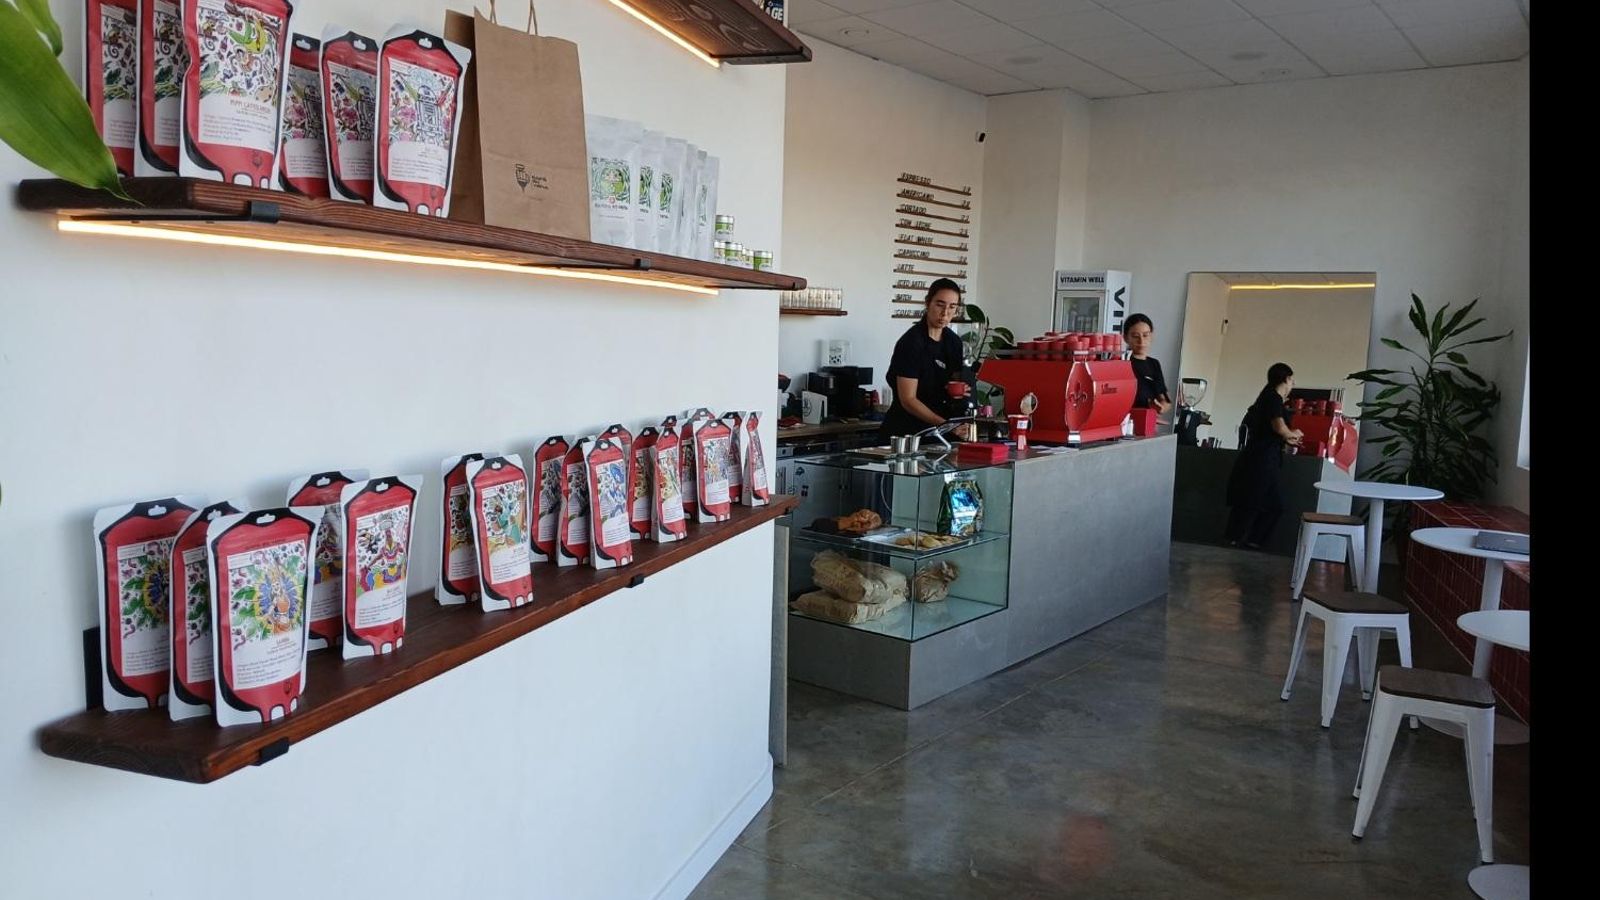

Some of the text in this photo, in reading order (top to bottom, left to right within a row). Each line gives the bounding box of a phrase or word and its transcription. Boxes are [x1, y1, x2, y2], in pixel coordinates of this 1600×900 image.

[901, 172, 931, 185] ESPRESSO
[901, 188, 934, 200] AMERICANO
[900, 203, 927, 214] CORTADO
[900, 233, 933, 245] FLAT WHITE
[896, 263, 914, 272] LATTE
